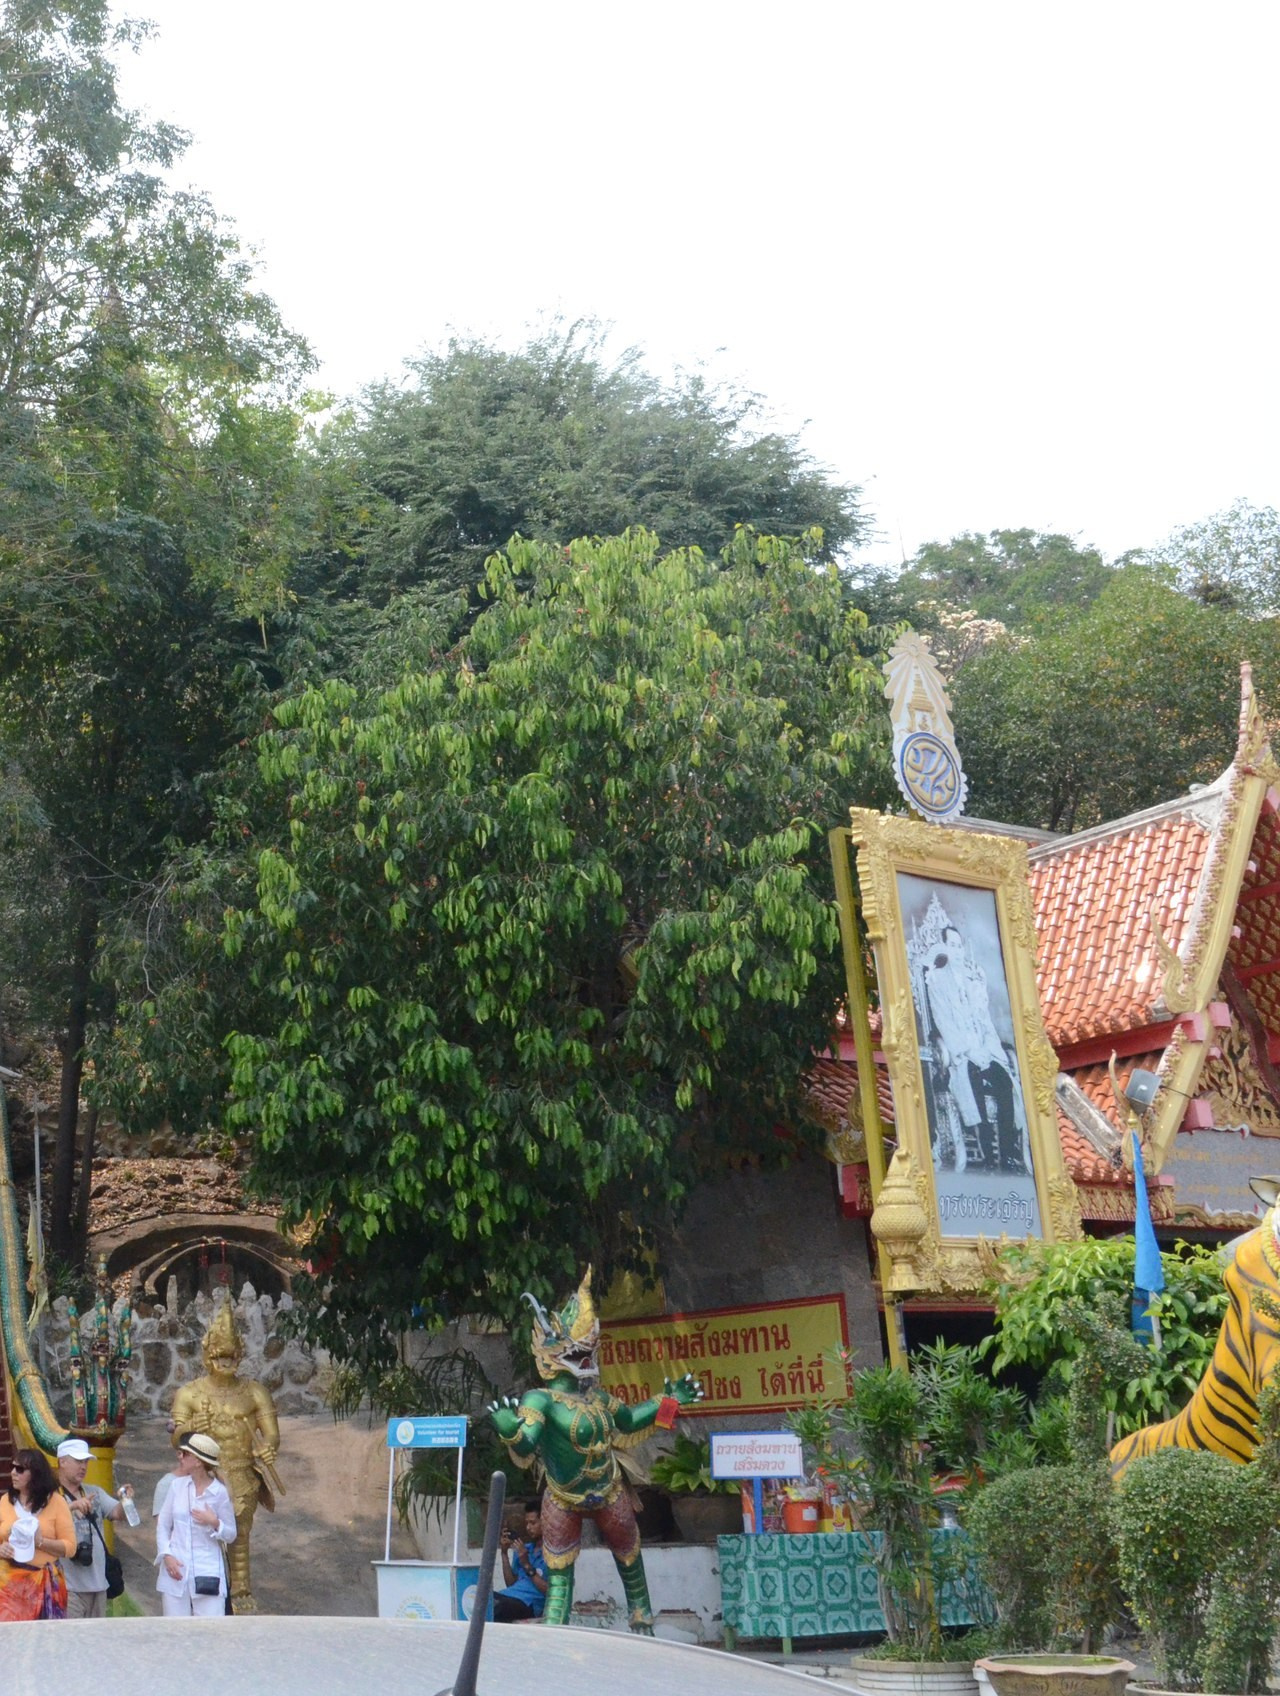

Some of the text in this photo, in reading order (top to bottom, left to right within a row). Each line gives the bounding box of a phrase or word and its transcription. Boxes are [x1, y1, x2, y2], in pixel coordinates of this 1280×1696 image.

[939, 1190, 1035, 1230] ทรงพระเจริญ
